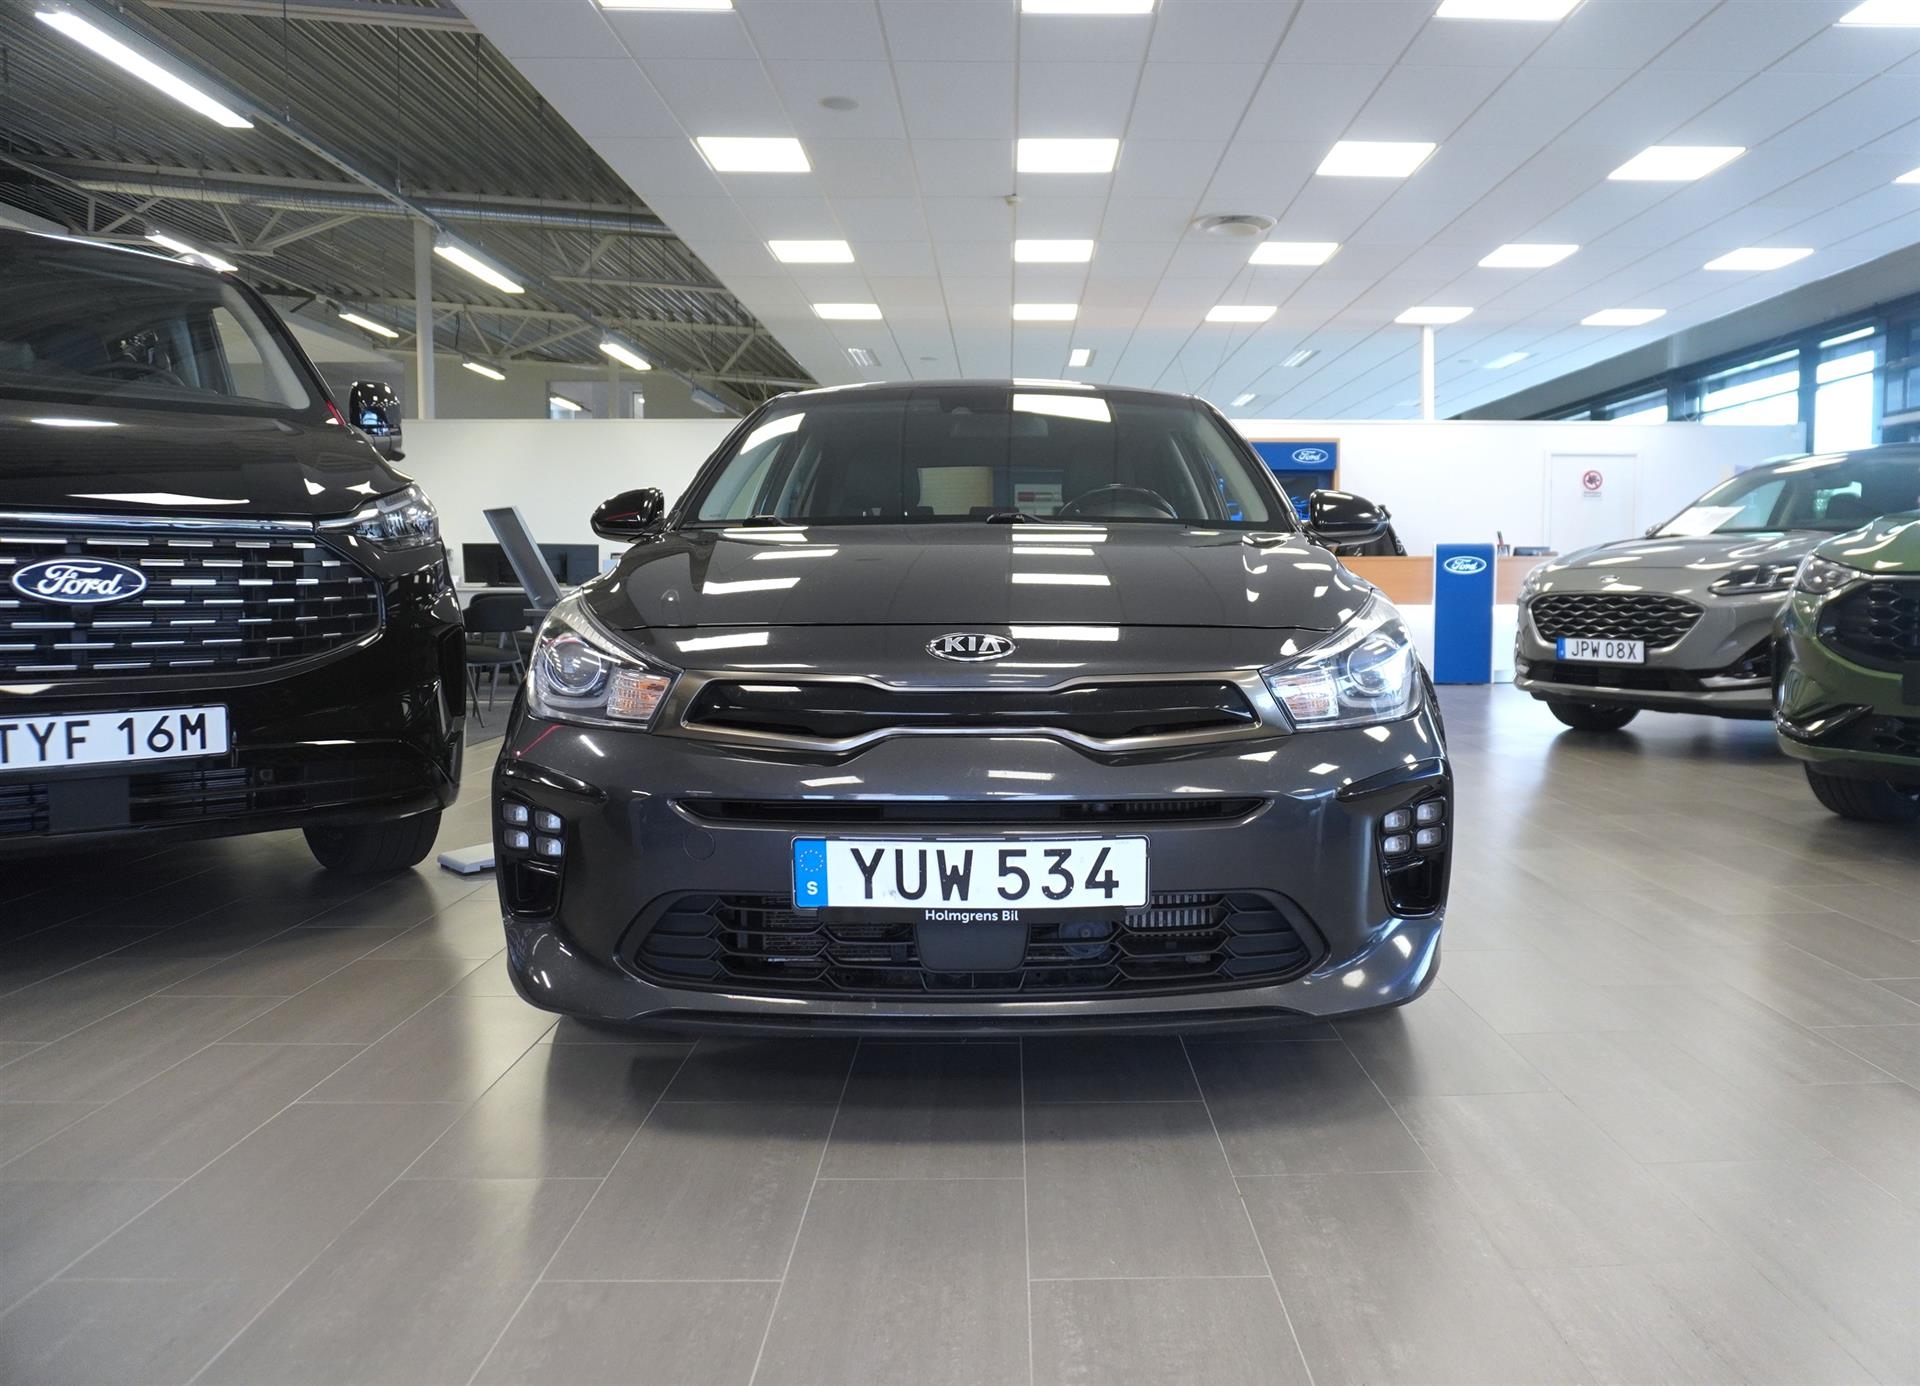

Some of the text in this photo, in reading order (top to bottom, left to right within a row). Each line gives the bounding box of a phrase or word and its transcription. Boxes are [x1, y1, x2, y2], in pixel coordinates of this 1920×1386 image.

[1298, 450, 1322, 461] Ford
[1451, 558, 1478, 571] Ford
[36, 564, 123, 596] Ford
[943, 636, 1002, 654] KIA
[1571, 640, 1637, 660] JPW 08X
[0, 713, 207, 763] TYF 16M
[850, 846, 1120, 902] YUW 534
[806, 881, 819, 896] S
[925, 908, 1019, 923] Holmgrens Bil
